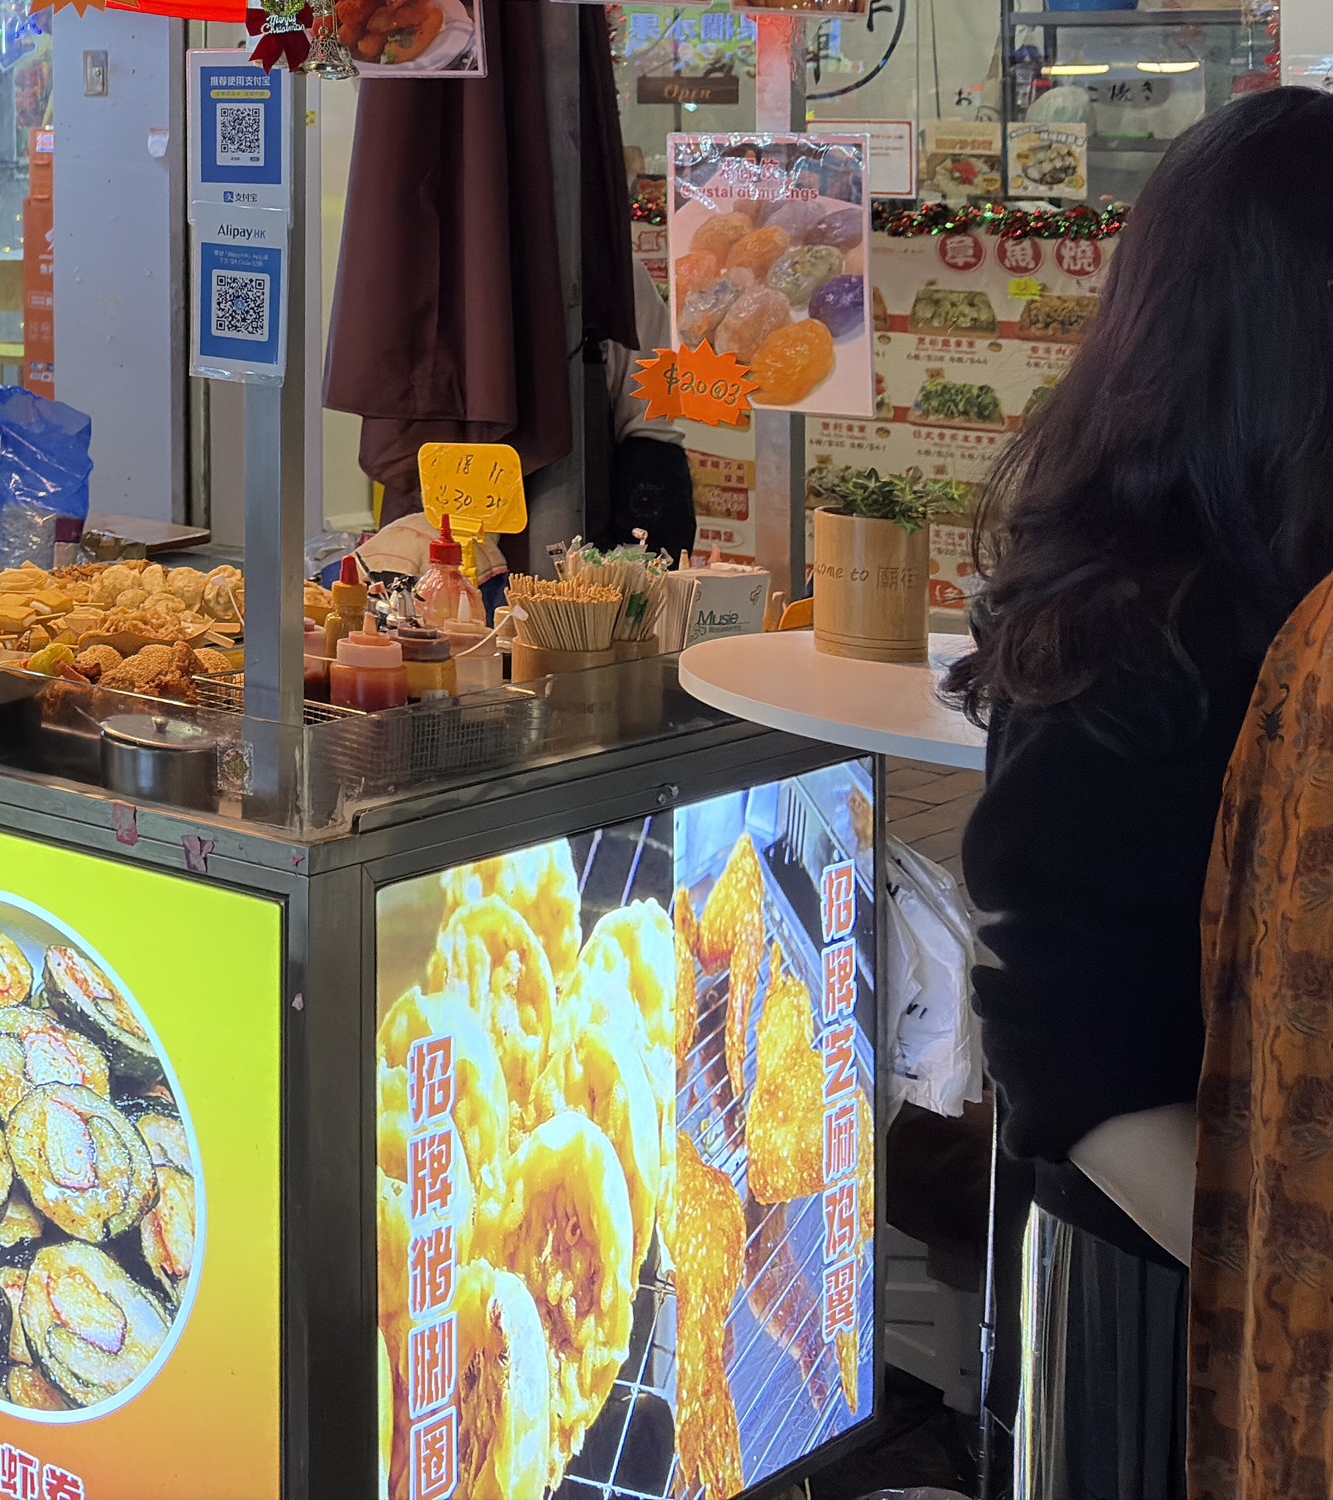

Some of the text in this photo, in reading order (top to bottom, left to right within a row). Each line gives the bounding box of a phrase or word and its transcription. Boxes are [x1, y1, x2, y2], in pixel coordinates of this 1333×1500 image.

[664, 83, 712, 101] Open
[850, 567, 870, 582] to
[820, 854, 858, 1343] 招牌芝麻鸡翼
[407, 1032, 458, 1500] 招牌猪脚圈
